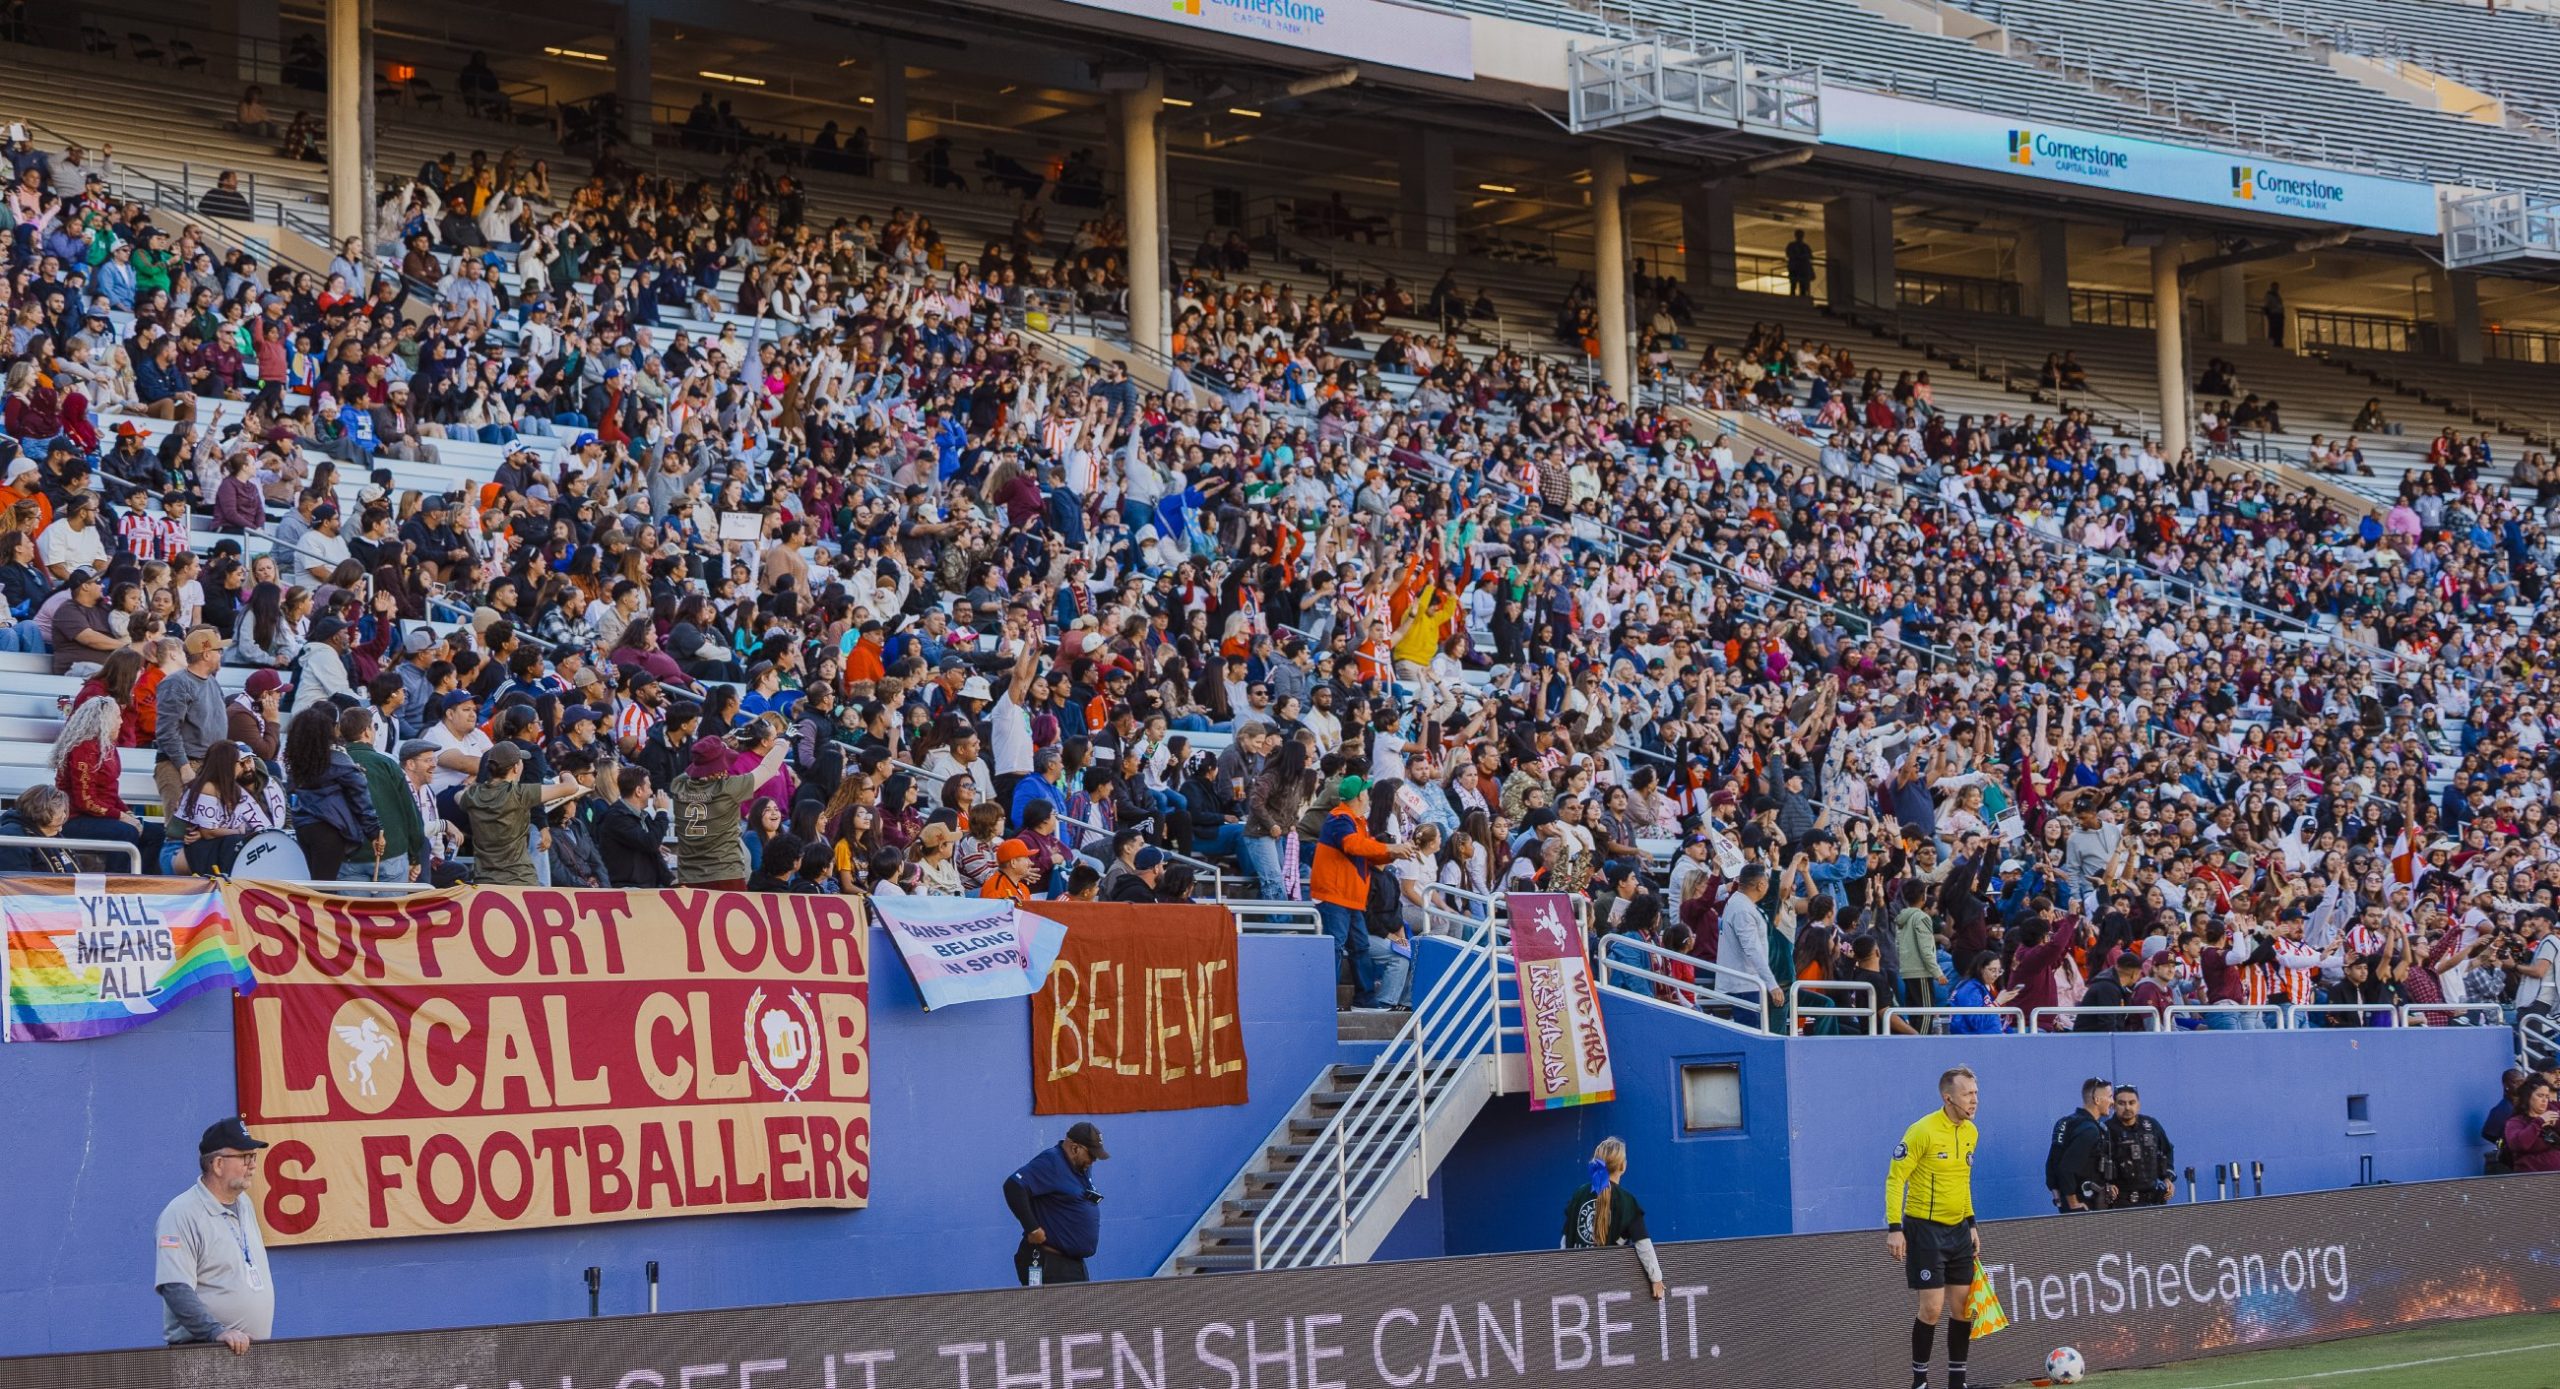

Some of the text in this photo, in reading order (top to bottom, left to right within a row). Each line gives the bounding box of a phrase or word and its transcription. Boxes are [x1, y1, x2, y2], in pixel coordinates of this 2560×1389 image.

[1211, 0, 1325, 25] ornerstone
[2036, 133, 2127, 169] Cornerstone
[2056, 161, 2110, 178] CAPITAL BANK
[2257, 170, 2344, 201] Cornerstone
[2276, 195, 2327, 210] CAPITAL BANK
[684, 802, 708, 837] 2
[246, 842, 277, 866] SPL
[80, 896, 159, 927] Y'ALL
[78, 929, 172, 964] MEANS
[238, 889, 865, 978] SUPPORT YOUR
[931, 931, 1015, 957] BELONG
[101, 966, 162, 1000] ALL
[1572, 970, 1592, 1015] WE
[1047, 959, 1242, 1084] BELIEVE
[252, 995, 612, 1117] LOCAL
[263, 1115, 869, 1235] & FOOTBALLERS
[1985, 1244, 2349, 1322] ThenSheCan.org
[938, 1327, 1166, 1389] THEN
[1195, 1313, 1347, 1389] SHE
[1373, 1299, 1526, 1388] CAN
[1551, 1291, 1635, 1372] BE
[1659, 1285, 1720, 1362] IT.
